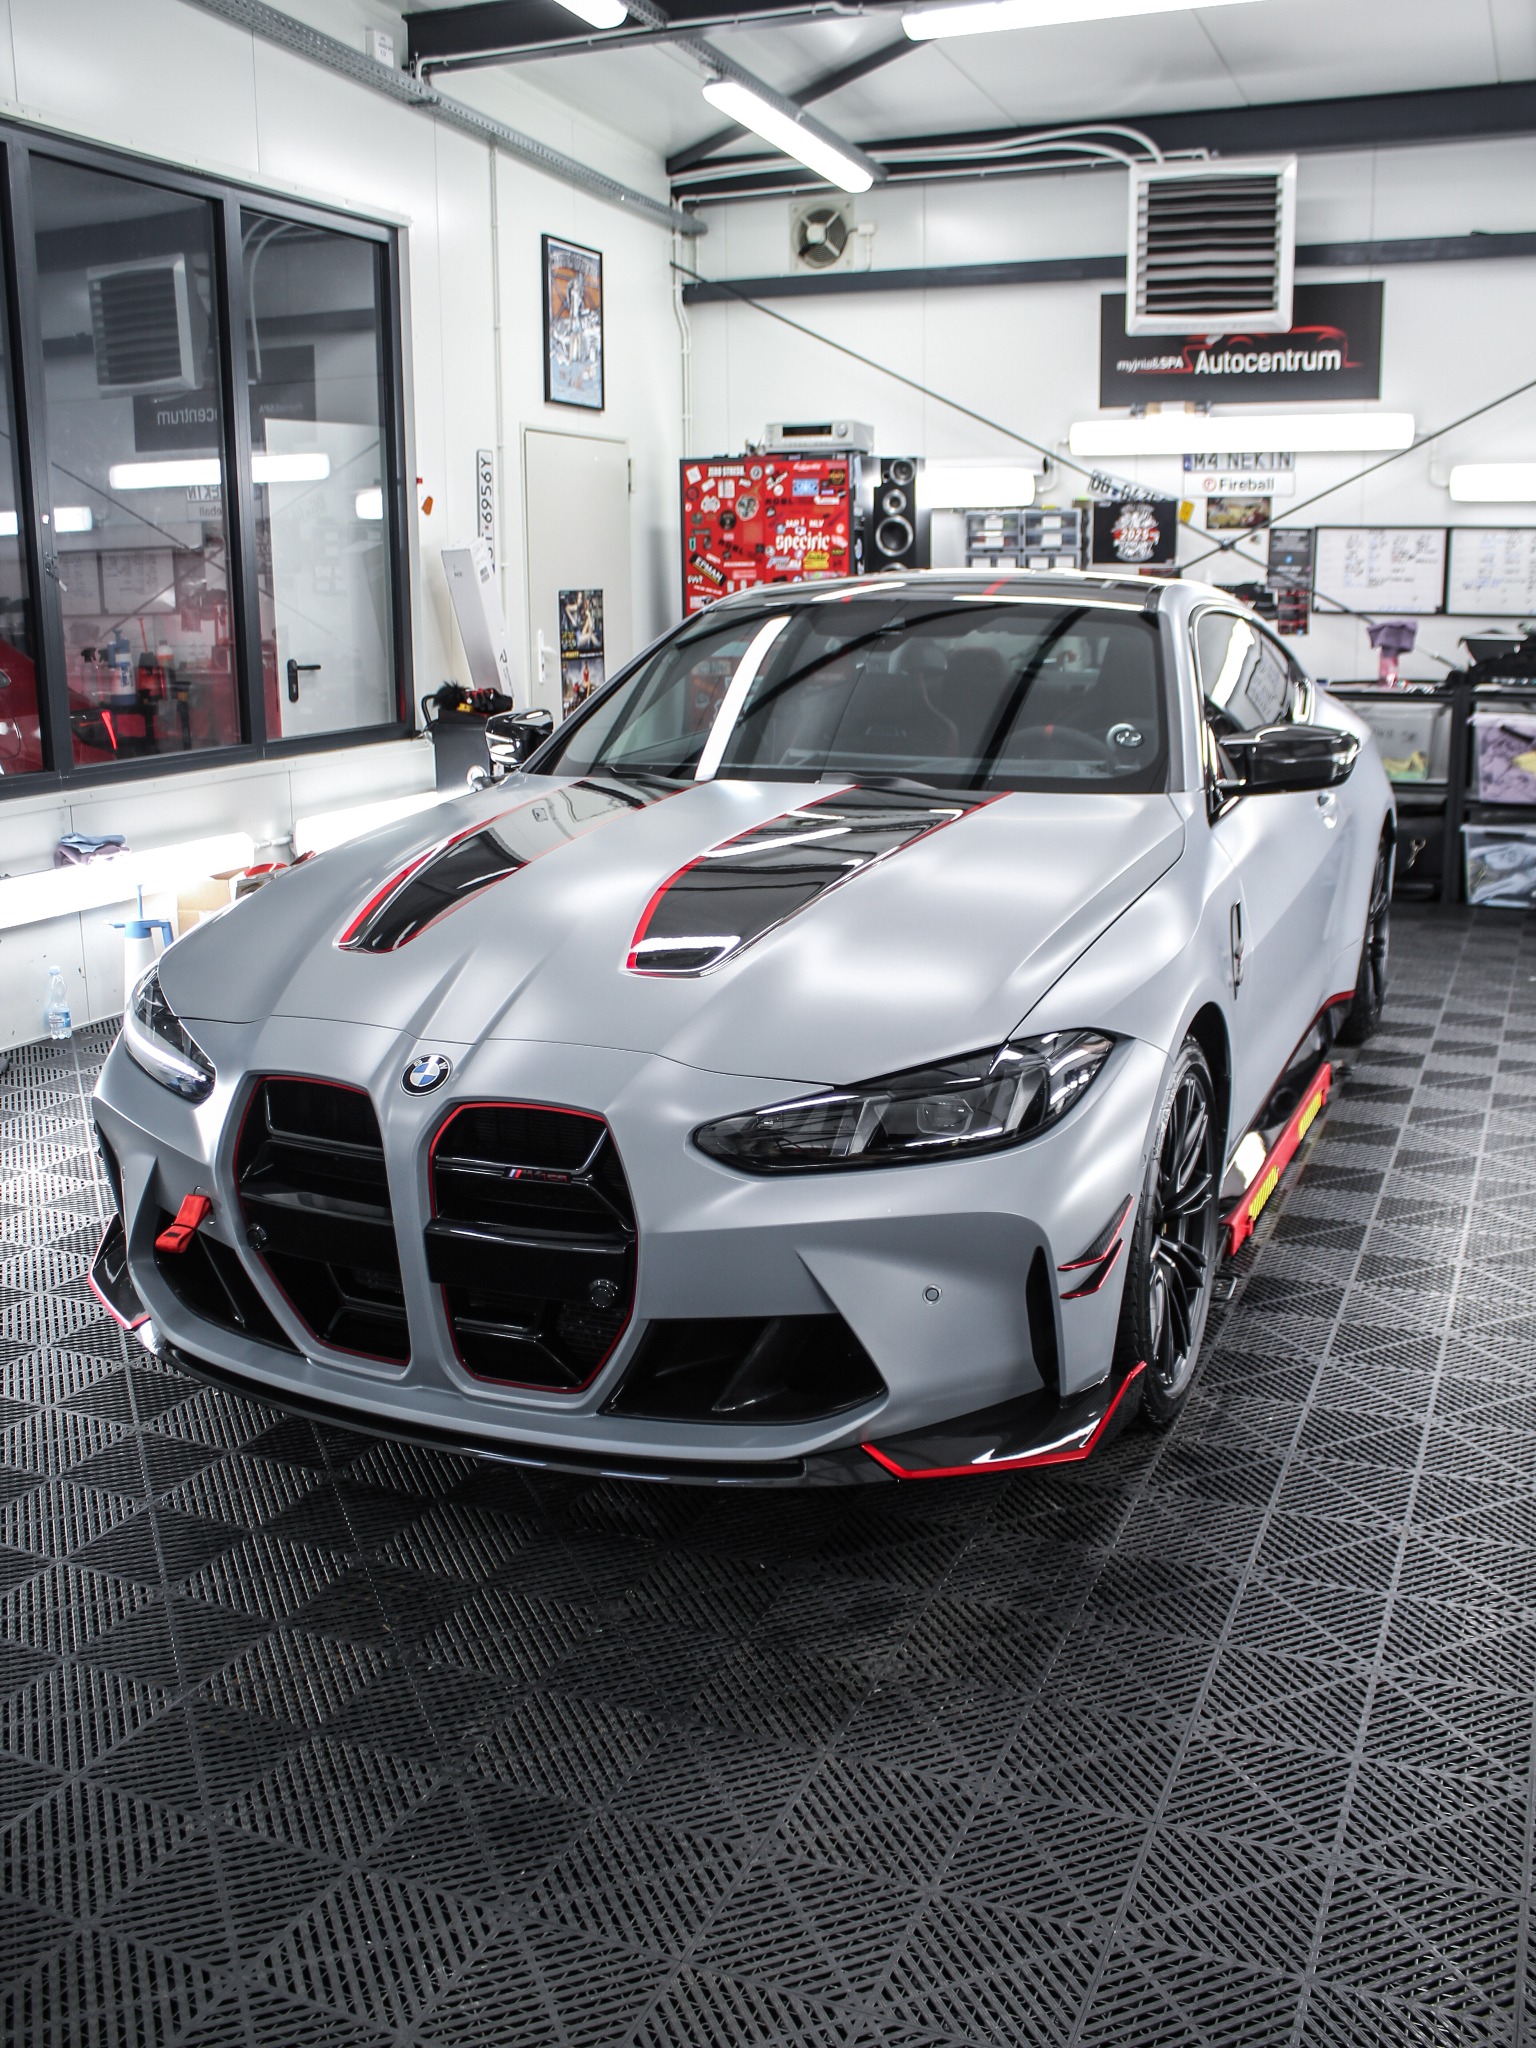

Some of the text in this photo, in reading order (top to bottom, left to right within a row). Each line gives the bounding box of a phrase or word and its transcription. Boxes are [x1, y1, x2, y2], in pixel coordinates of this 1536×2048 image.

[1194, 349, 1342, 375] Autocentrum
[479, 457, 493, 524] 6956Y
[1219, 477, 1275, 492] Fireball
